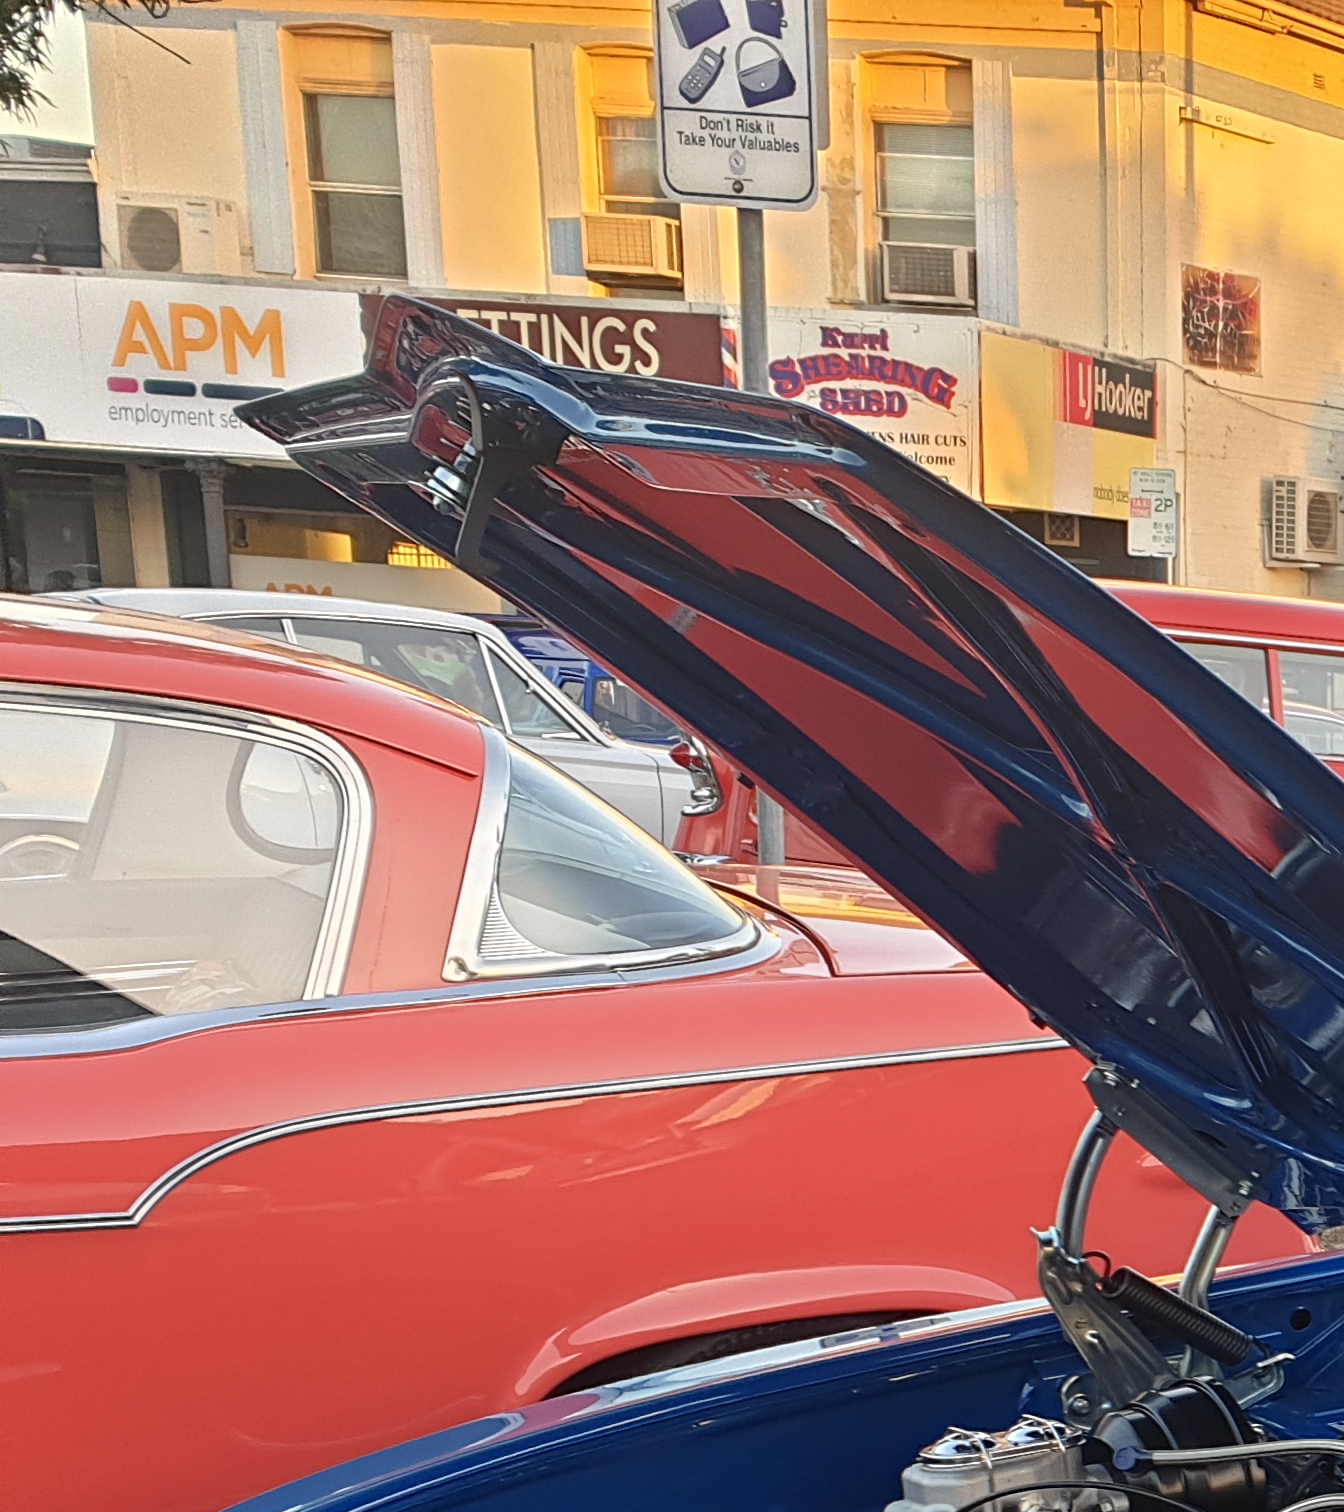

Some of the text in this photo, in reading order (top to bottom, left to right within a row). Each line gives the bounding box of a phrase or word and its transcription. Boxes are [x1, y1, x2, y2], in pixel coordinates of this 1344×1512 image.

[699, 115, 731, 132] Don't
[736, 118, 763, 134] Risk
[677, 130, 800, 153] Take Your Valuables
[111, 300, 286, 378] APM
[769, 353, 959, 410] SHEARING
[1093, 366, 1153, 420] Hooker
[819, 387, 908, 418] SHED
[108, 404, 216, 429] employment
[899, 432, 930, 446] HAIR
[934, 434, 967, 448] CUTS
[901, 451, 956, 466] elcome
[1154, 498, 1174, 513] 2P
